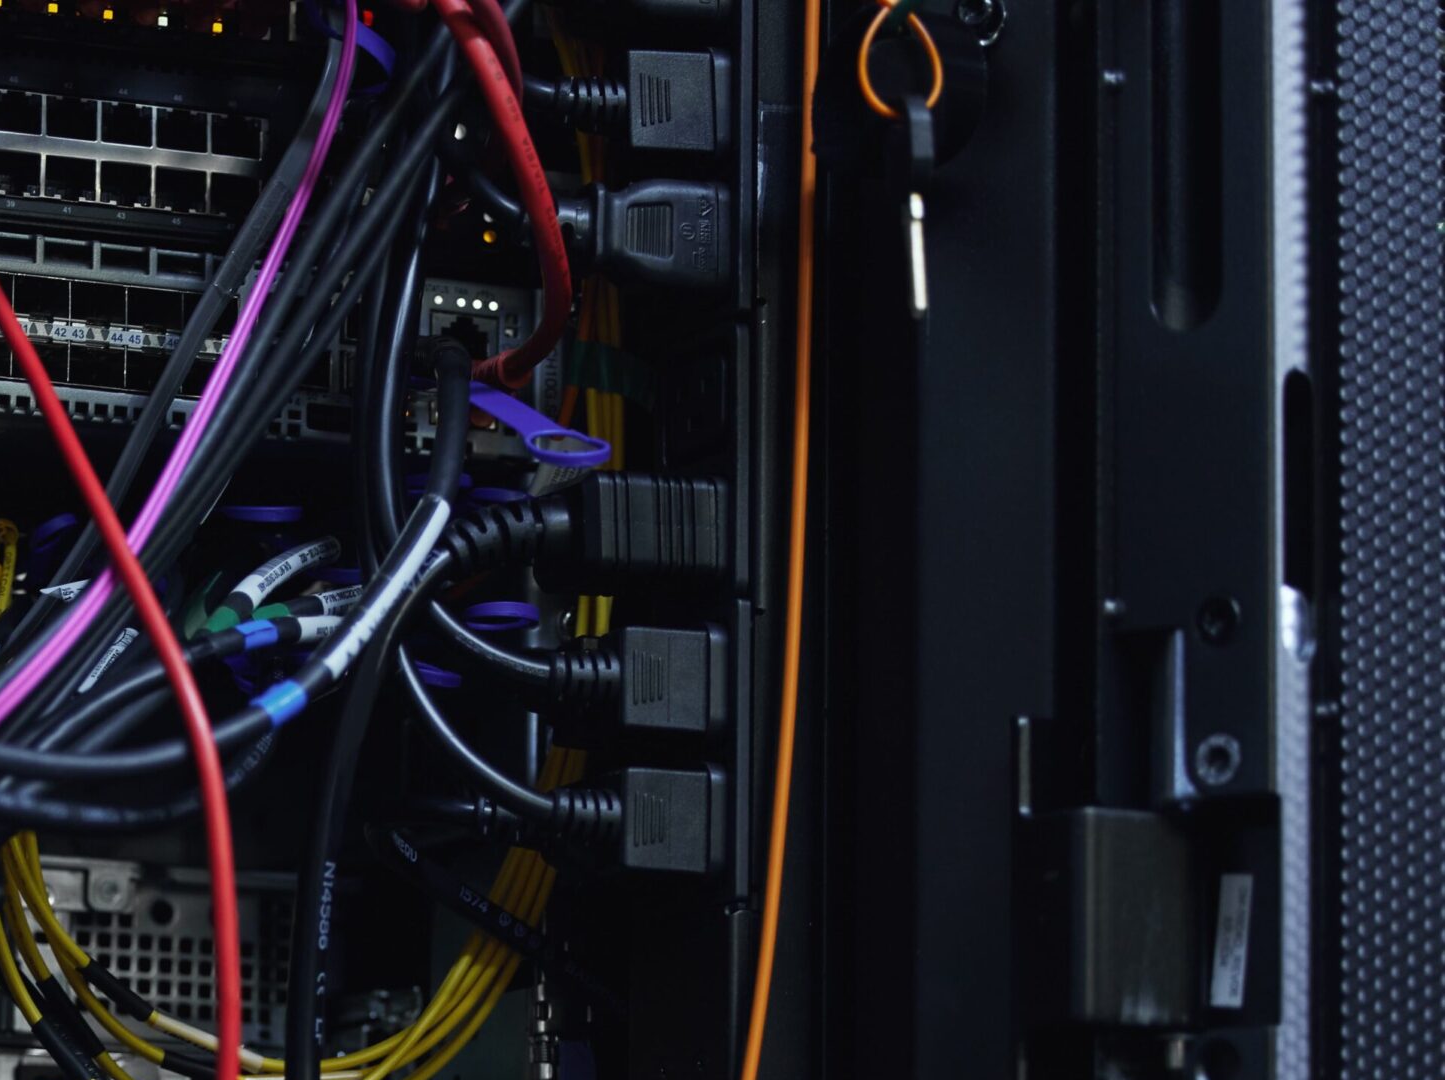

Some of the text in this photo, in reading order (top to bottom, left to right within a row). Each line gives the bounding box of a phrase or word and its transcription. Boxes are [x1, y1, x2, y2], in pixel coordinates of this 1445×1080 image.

[6, 200, 16, 208] 39
[62, 206, 72, 214] 41
[116, 212, 126, 220] 43
[172, 217, 182, 225] 45
[54, 327, 67, 338] 42
[71, 328, 85, 339] 43
[111, 332, 124, 343] 44
[128, 333, 142, 345] 45
[317, 861, 337, 951] N14586
